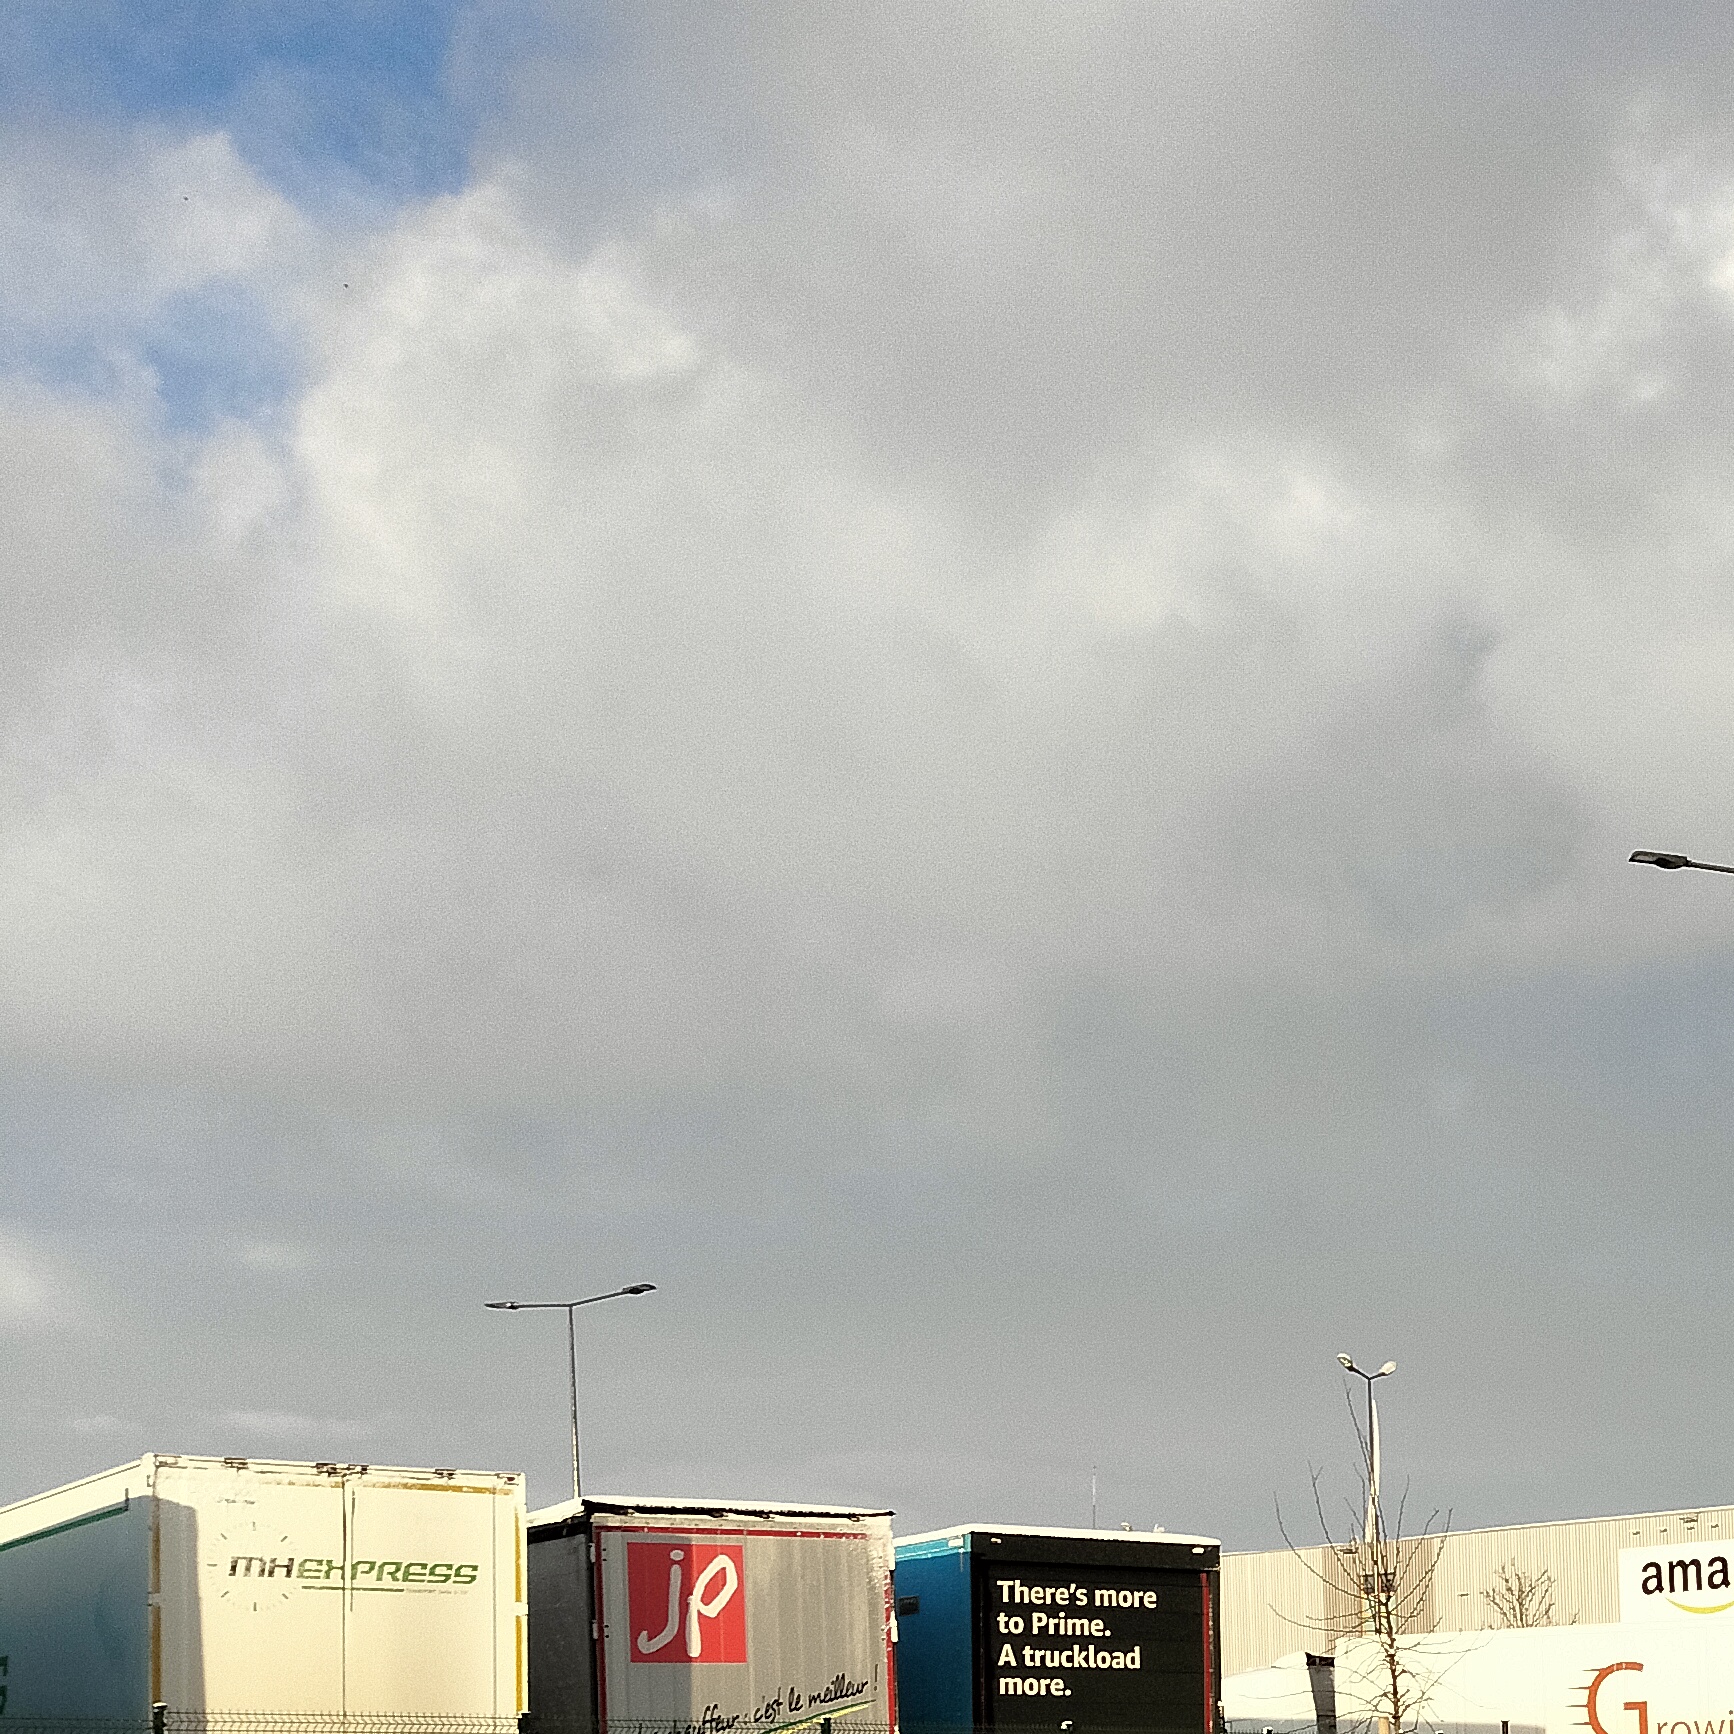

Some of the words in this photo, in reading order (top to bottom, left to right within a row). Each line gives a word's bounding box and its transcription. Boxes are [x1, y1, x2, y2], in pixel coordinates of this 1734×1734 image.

[997, 1579, 1088, 1606] There's
[1094, 1588, 1157, 1609] more
[996, 1611, 1025, 1634] to
[1031, 1611, 1112, 1637] Prime.
[998, 1643, 1018, 1667] A
[1022, 1644, 1141, 1669] truckload
[788, 1687, 803, 1712] le
[999, 1677, 1072, 1696] more.
